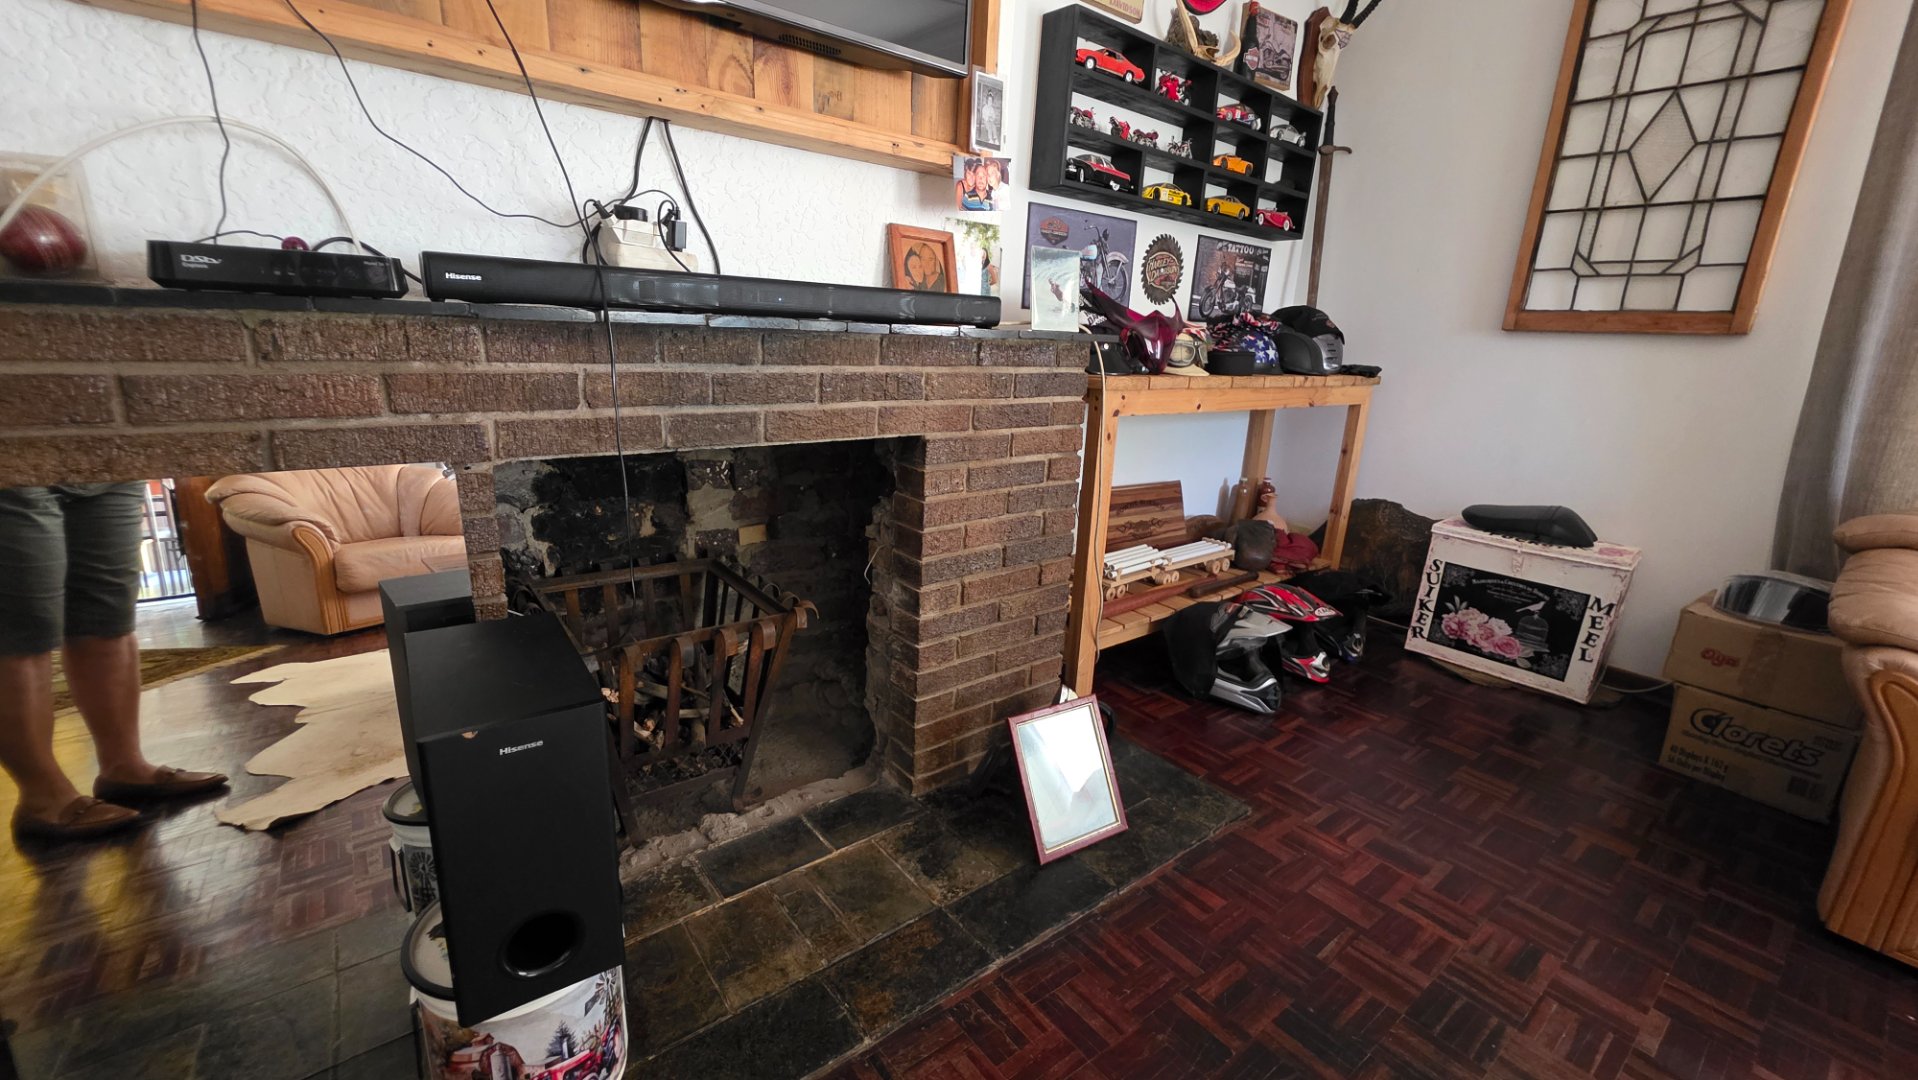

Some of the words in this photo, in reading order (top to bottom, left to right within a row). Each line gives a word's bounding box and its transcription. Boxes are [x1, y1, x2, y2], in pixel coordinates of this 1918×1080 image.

[1228, 243, 1254, 254] TATTOO
[445, 271, 482, 281] Hisense
[1412, 559, 1443, 640] SUIKER
[1578, 595, 1617, 663] MEEL
[499, 740, 544, 756] Hisense
[1690, 708, 1824, 766] Clorets
